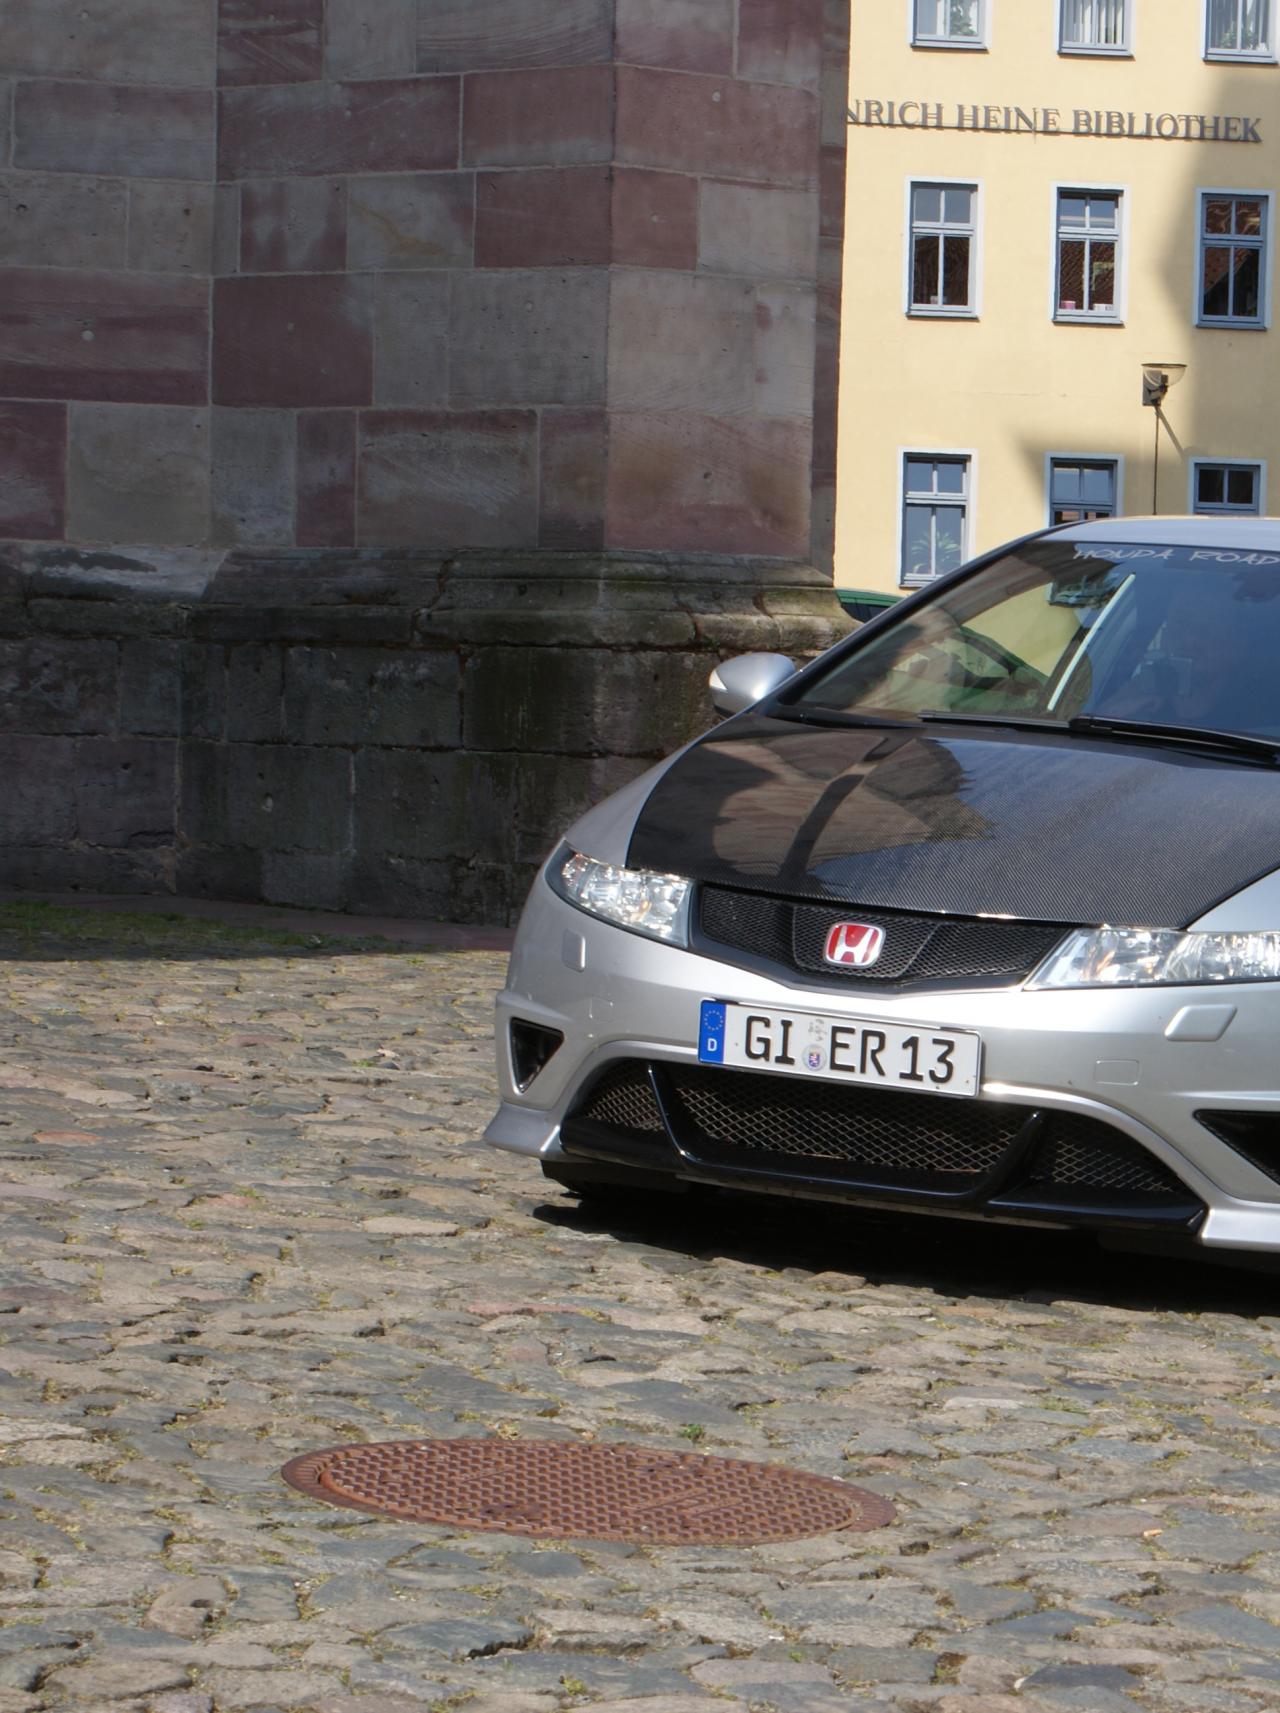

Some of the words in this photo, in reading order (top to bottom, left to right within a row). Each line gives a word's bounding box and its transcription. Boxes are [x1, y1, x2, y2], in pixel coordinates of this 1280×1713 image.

[956, 103, 1061, 134] HEINE
[1072, 108, 1263, 144] BIBLIOTHEK
[1073, 548, 1174, 560] HONDA
[744, 1014, 796, 1066] GI
[829, 1025, 887, 1077] ER
[899, 1036, 956, 1084] 13
